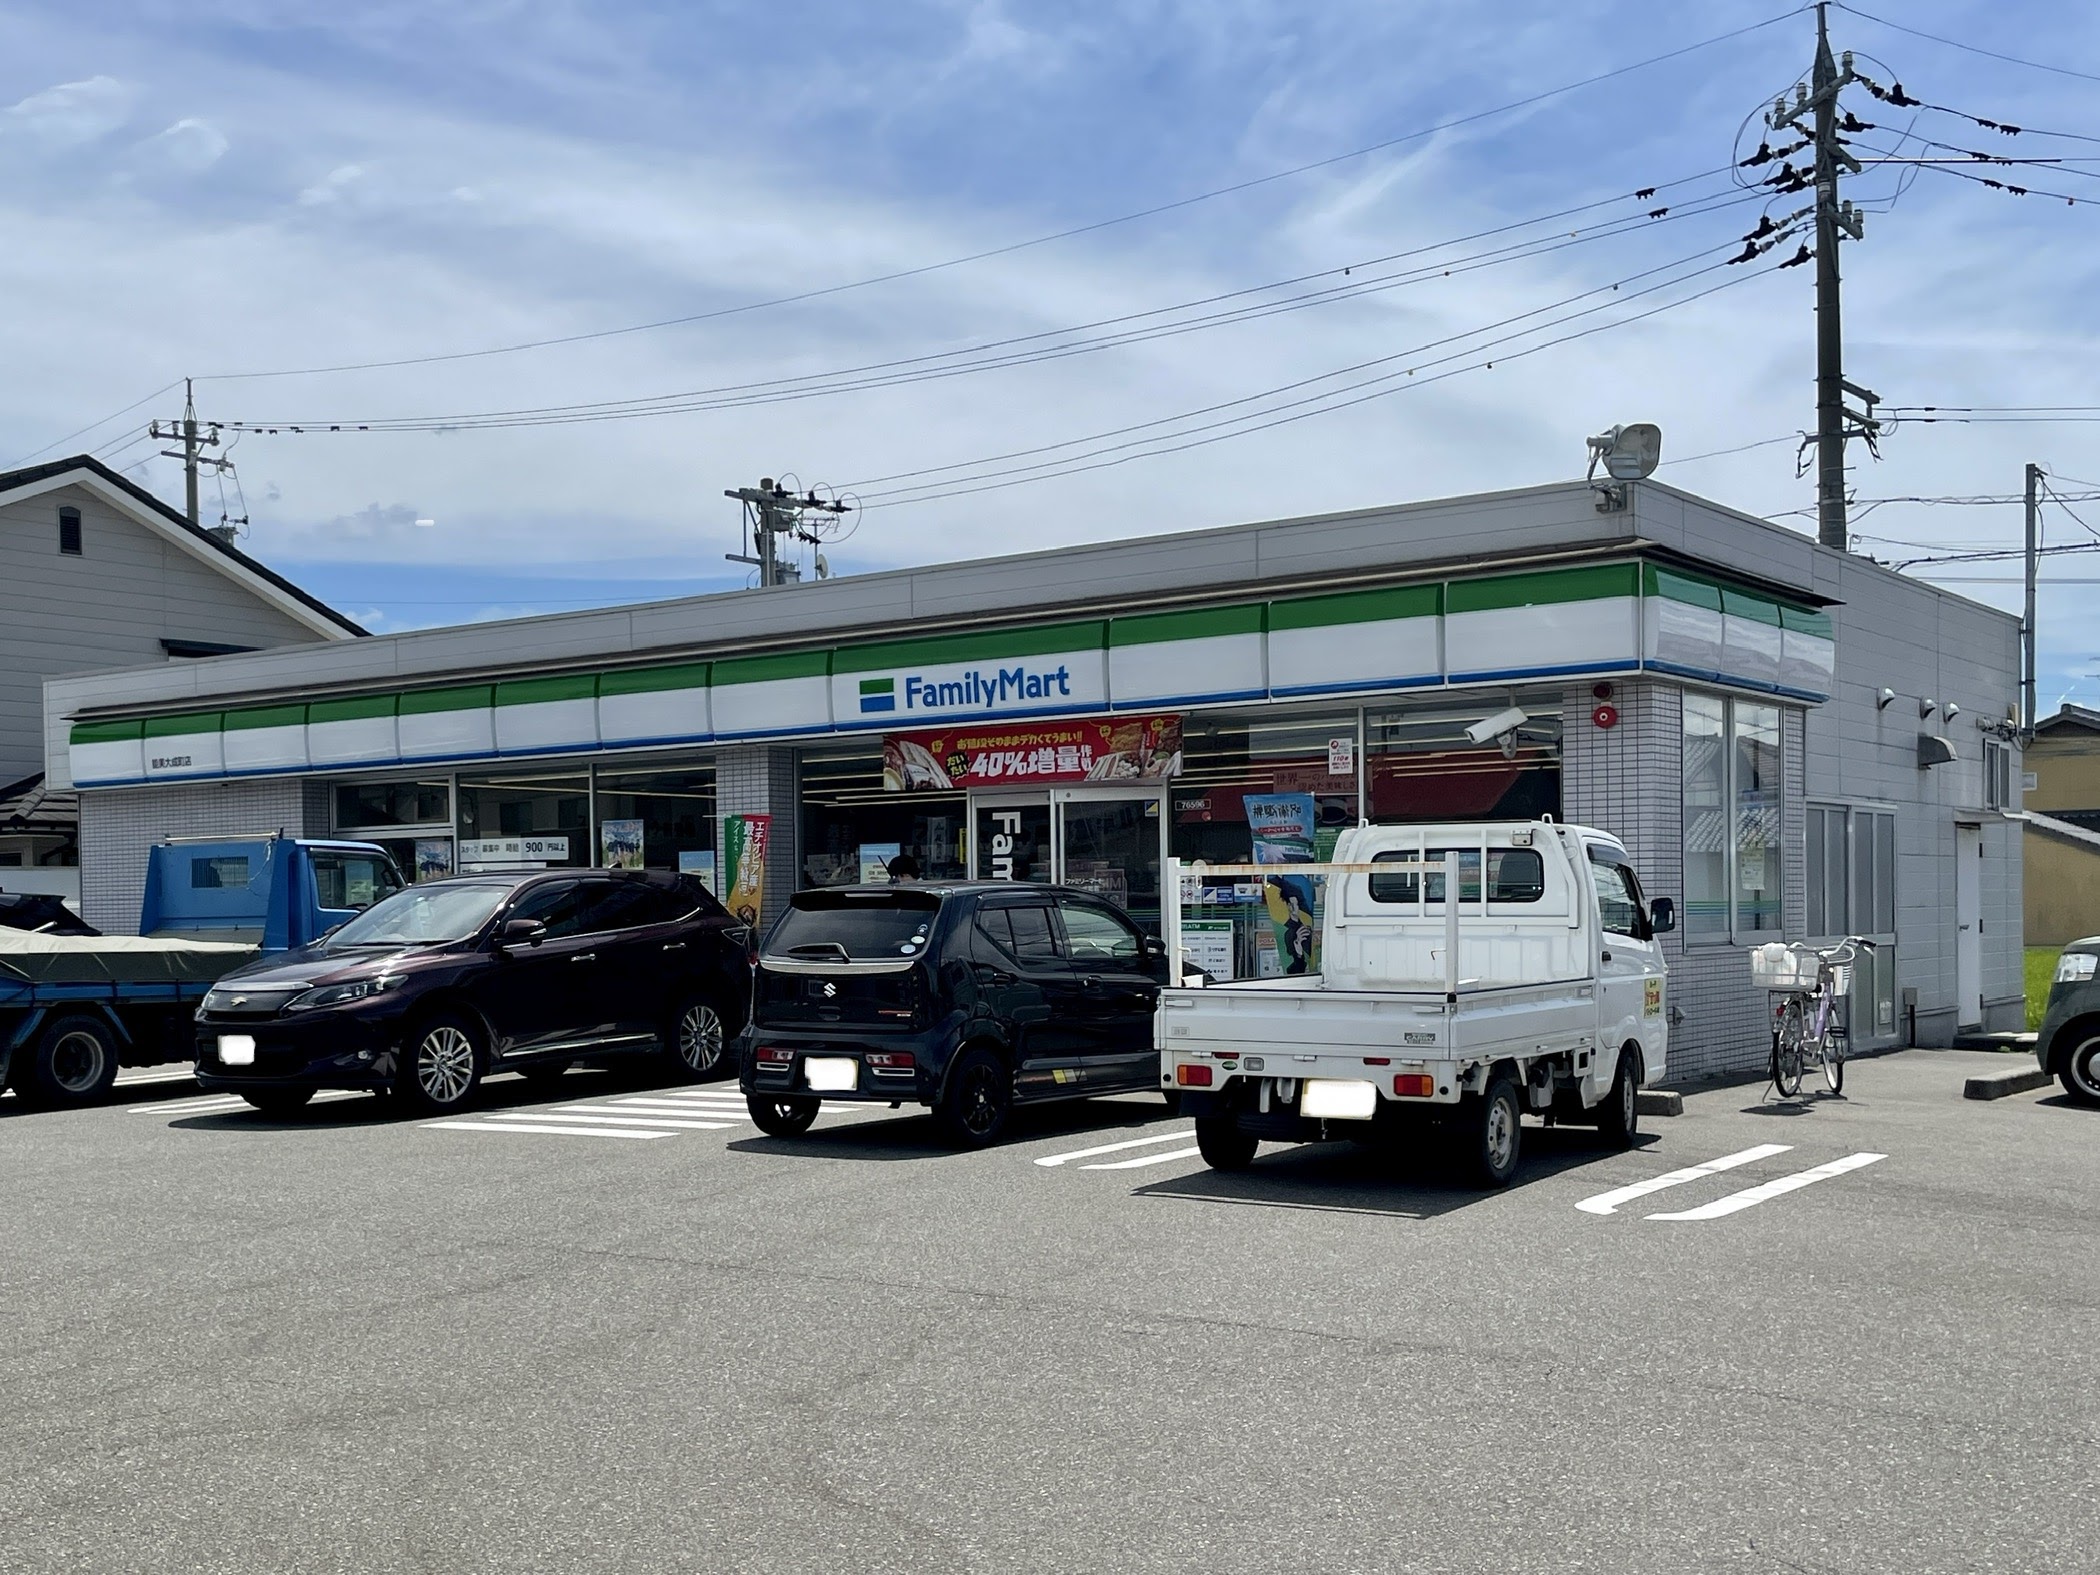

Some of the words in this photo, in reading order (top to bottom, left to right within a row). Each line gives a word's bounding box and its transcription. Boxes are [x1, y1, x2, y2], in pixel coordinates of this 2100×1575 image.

[905, 665, 1070, 709] FamilyMart
[1181, 801, 1205, 809] 76596
[525, 842, 543, 853] 900
